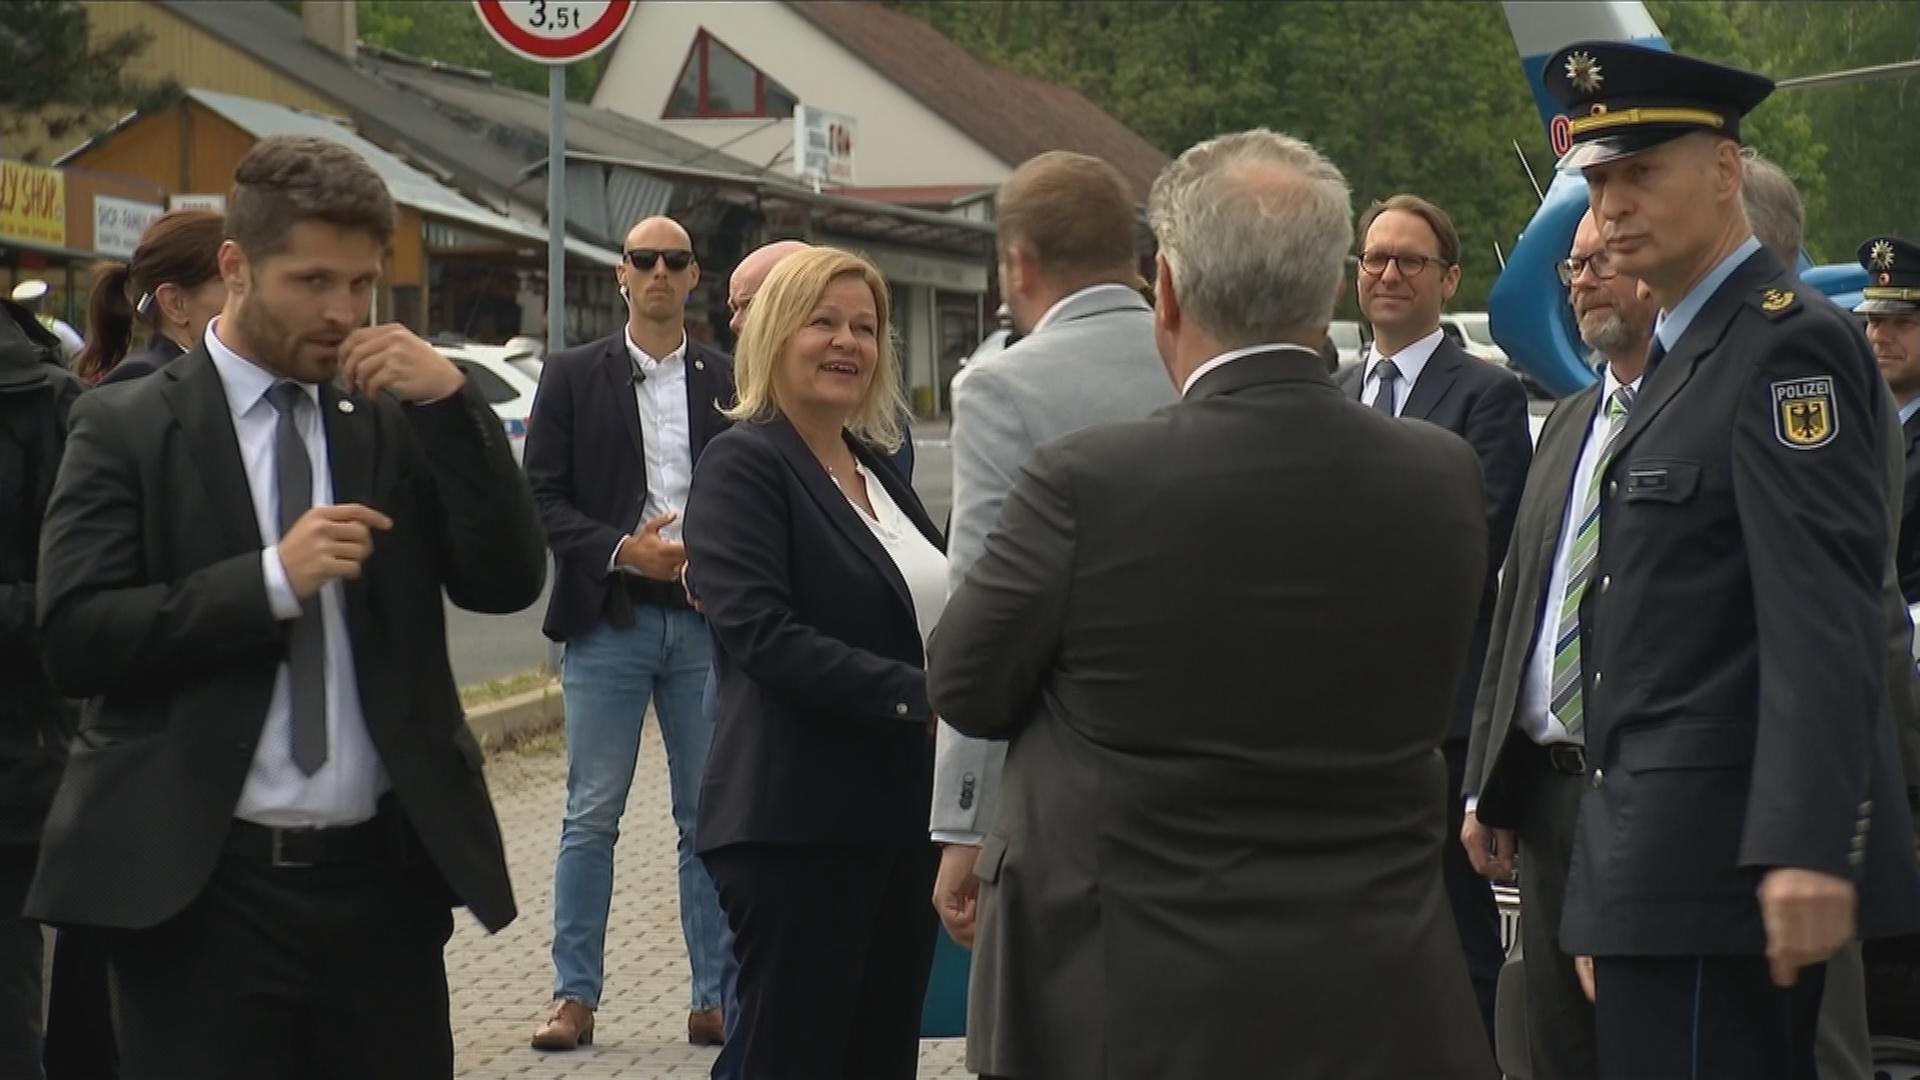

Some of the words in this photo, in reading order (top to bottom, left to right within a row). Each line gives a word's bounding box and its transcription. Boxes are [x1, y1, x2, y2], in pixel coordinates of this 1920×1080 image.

[0, 163, 18, 216] LY
[22, 166, 57, 220] SHOP
[1776, 382, 1829, 401] POLIZEI
